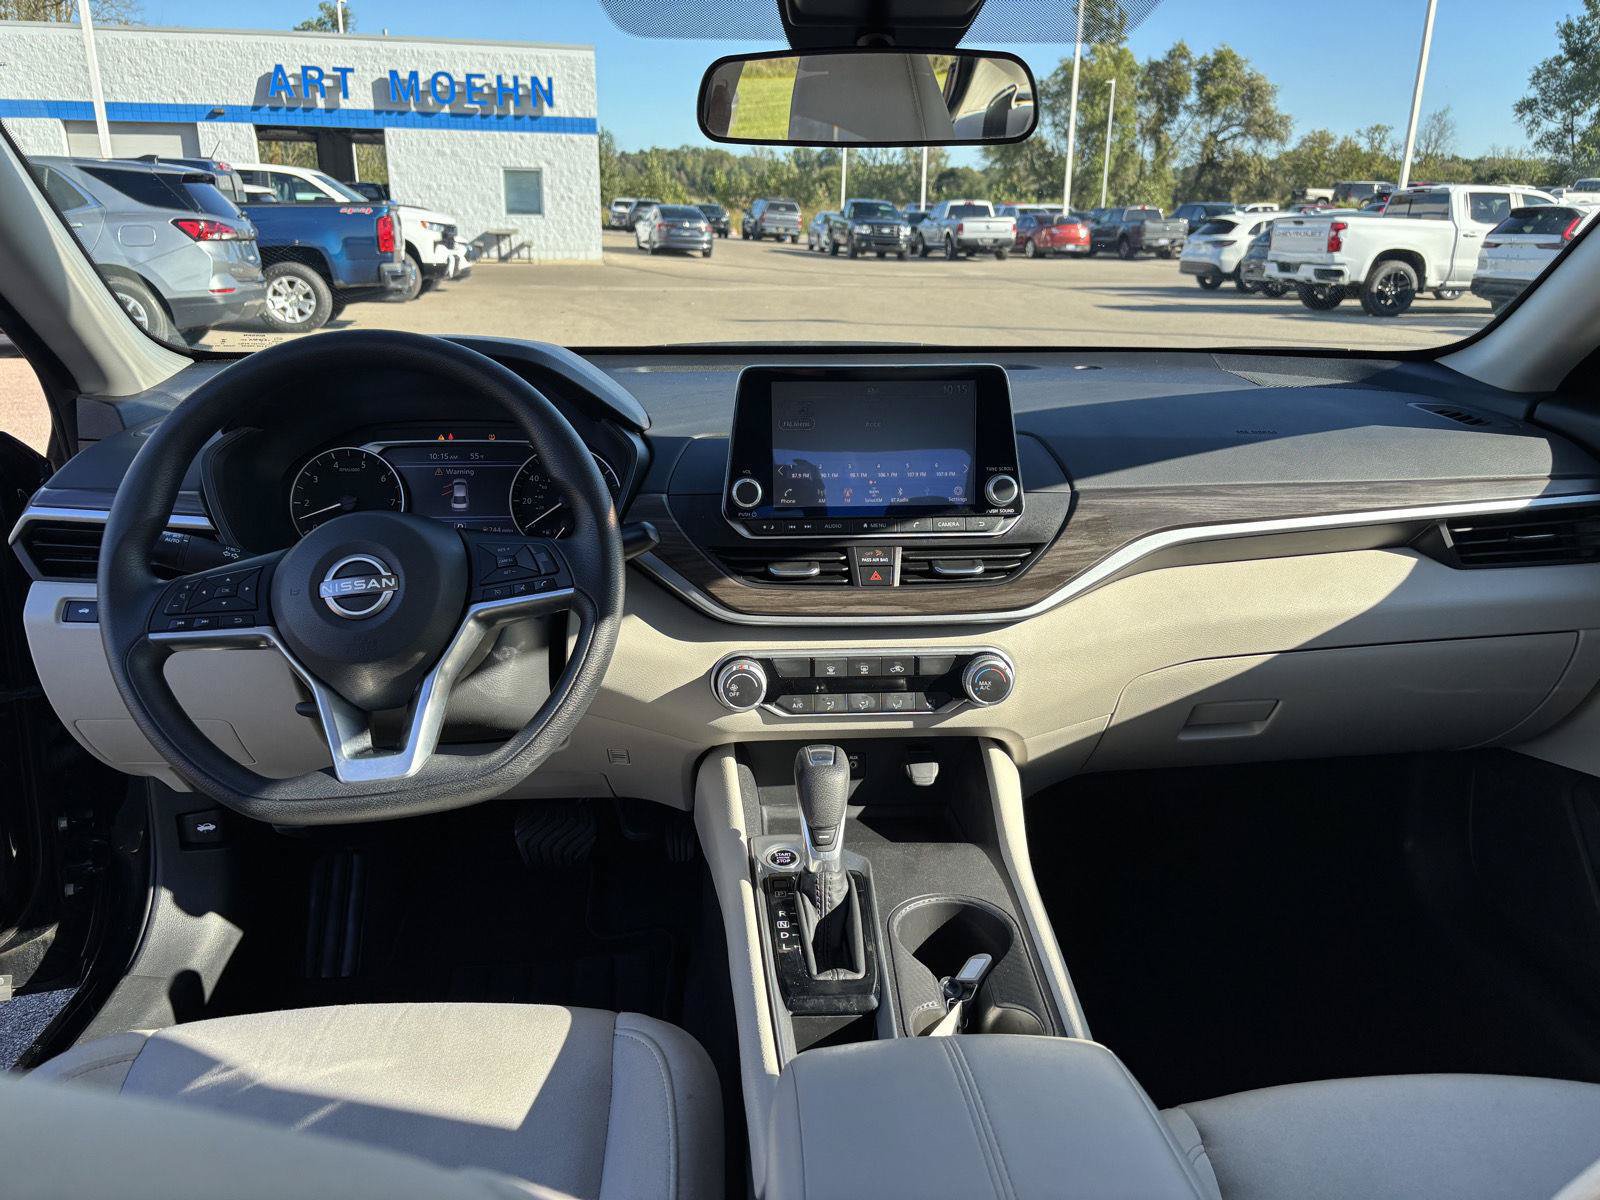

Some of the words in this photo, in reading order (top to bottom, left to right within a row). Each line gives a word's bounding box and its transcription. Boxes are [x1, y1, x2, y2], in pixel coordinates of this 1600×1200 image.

[269, 64, 355, 99] ART
[388, 69, 554, 108] MOEHN
[446, 468, 475, 476] Warning
[322, 577, 395, 594] NISSAN
